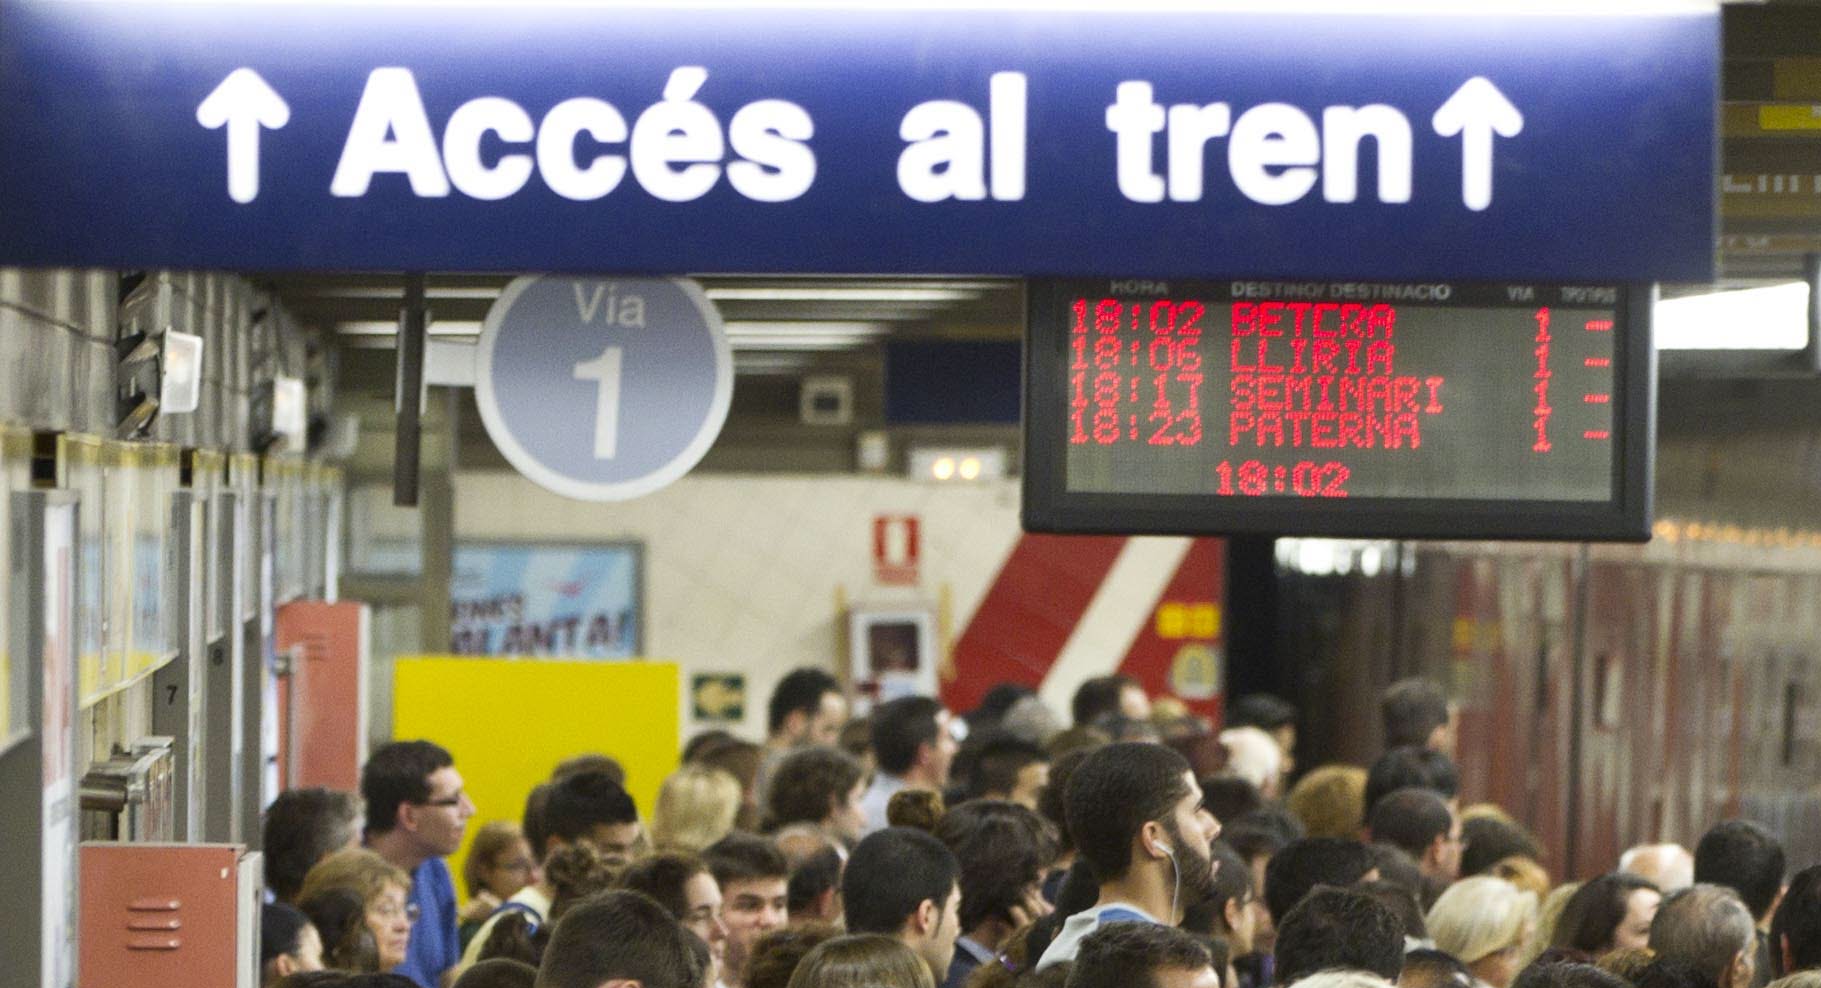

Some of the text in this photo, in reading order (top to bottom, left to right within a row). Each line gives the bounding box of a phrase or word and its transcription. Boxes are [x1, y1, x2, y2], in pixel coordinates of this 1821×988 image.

[330, 66, 1412, 205] Accés al tren
[572, 281, 647, 328] Via
[1072, 298, 1205, 335] 18:02
[1535, 307, 1551, 342] 1
[1071, 336, 1552, 378] 18:06 LLIRIA 1
[572, 346, 621, 460] 1
[1071, 371, 1552, 415] 18:17 SEMINARI 1
[1070, 408, 1552, 452] 18:23 PATERNA 1
[1216, 459, 1350, 498] 18:02
[166, 684, 178, 705] 7
